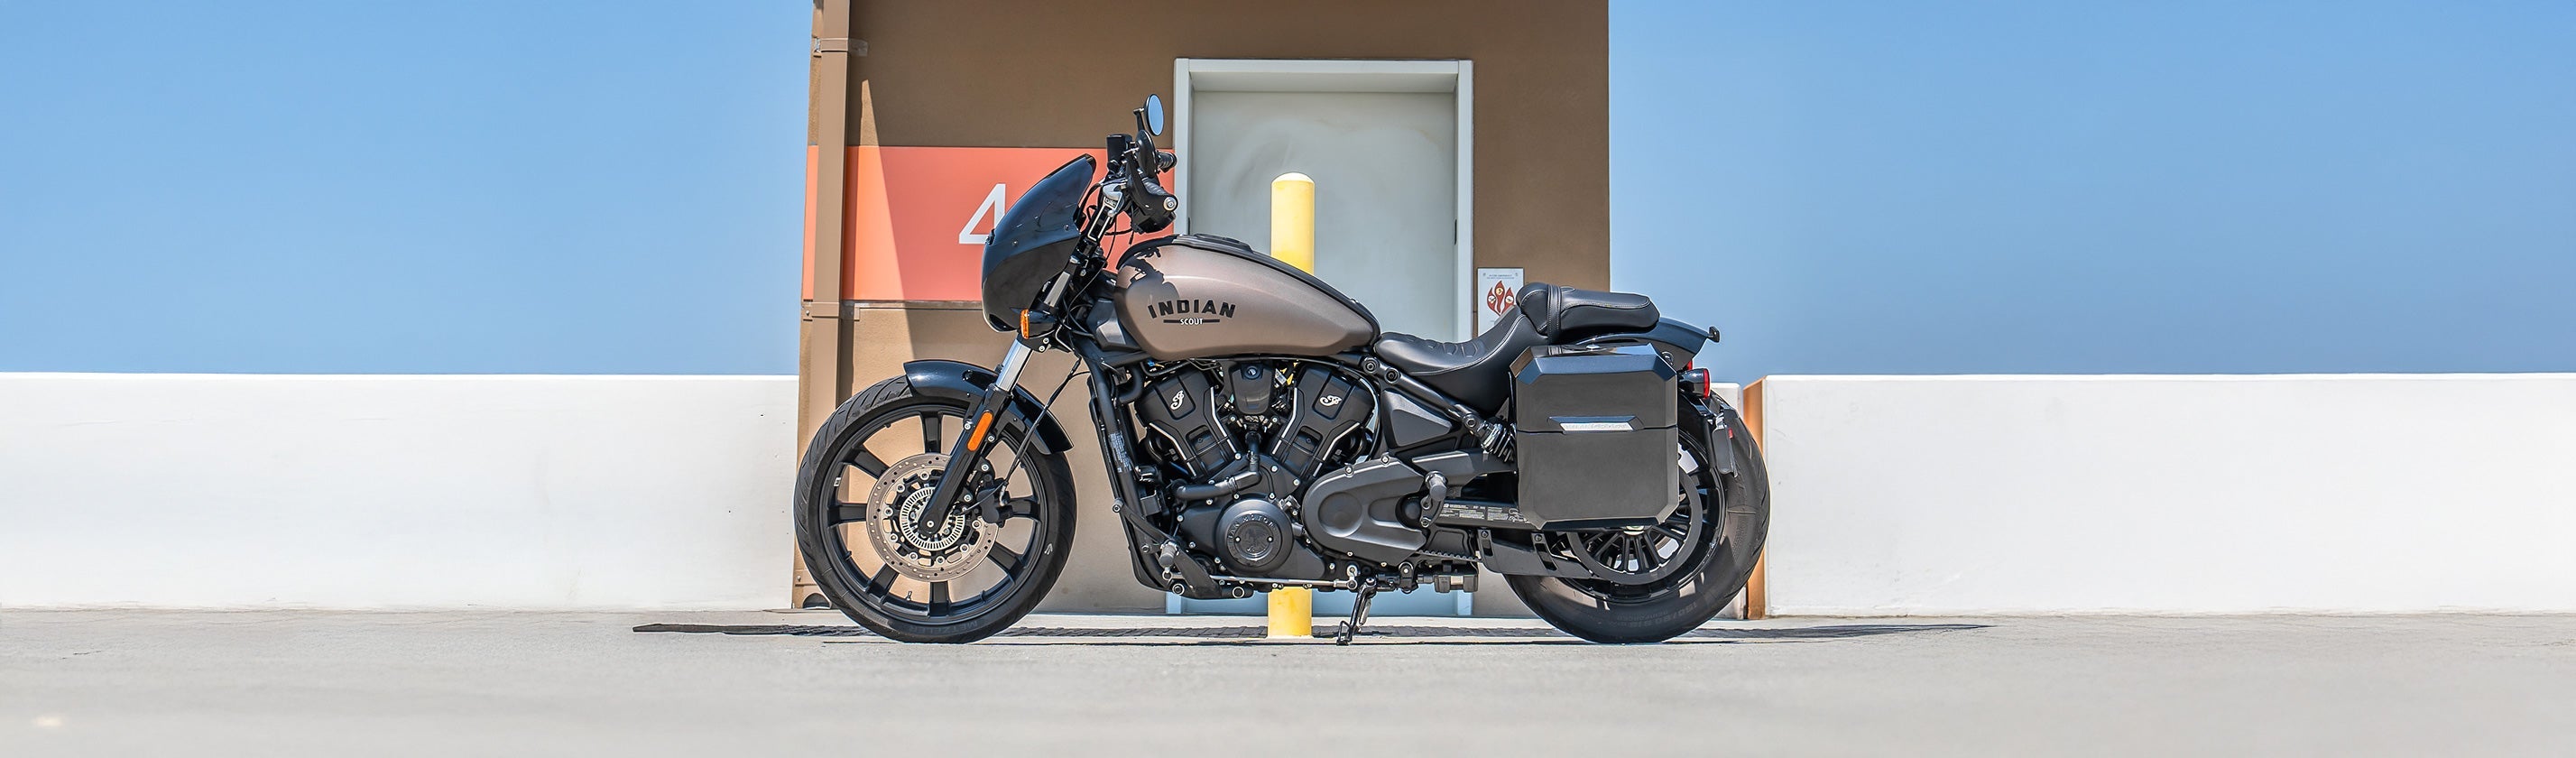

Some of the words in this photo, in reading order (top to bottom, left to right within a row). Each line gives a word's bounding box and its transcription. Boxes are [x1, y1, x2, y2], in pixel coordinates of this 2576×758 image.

[959, 183, 1006, 244] 4
[1147, 300, 1236, 319] INDIAN
[1179, 318, 1204, 326] SCOUT
[909, 620, 979, 634] METZELER
